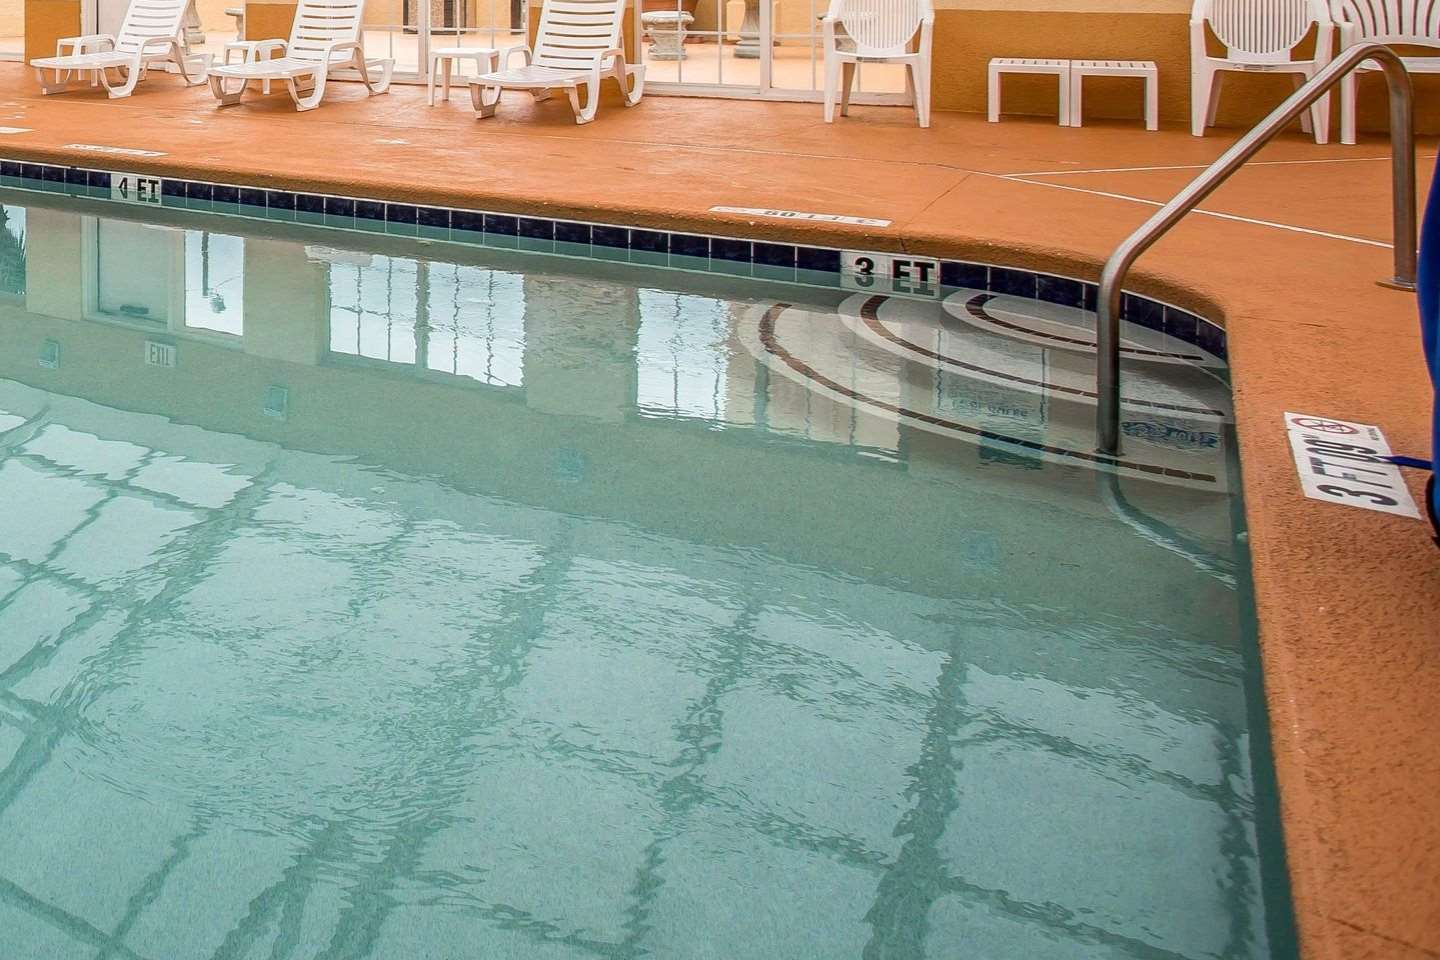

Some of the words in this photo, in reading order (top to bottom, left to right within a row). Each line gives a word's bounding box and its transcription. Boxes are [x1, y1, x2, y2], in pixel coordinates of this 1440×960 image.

[137, 178, 159, 195] FT
[855, 257, 874, 276] 3
[893, 259, 935, 281] FT
[1309, 456, 1392, 489] FT
[1316, 485, 1398, 506] 3
